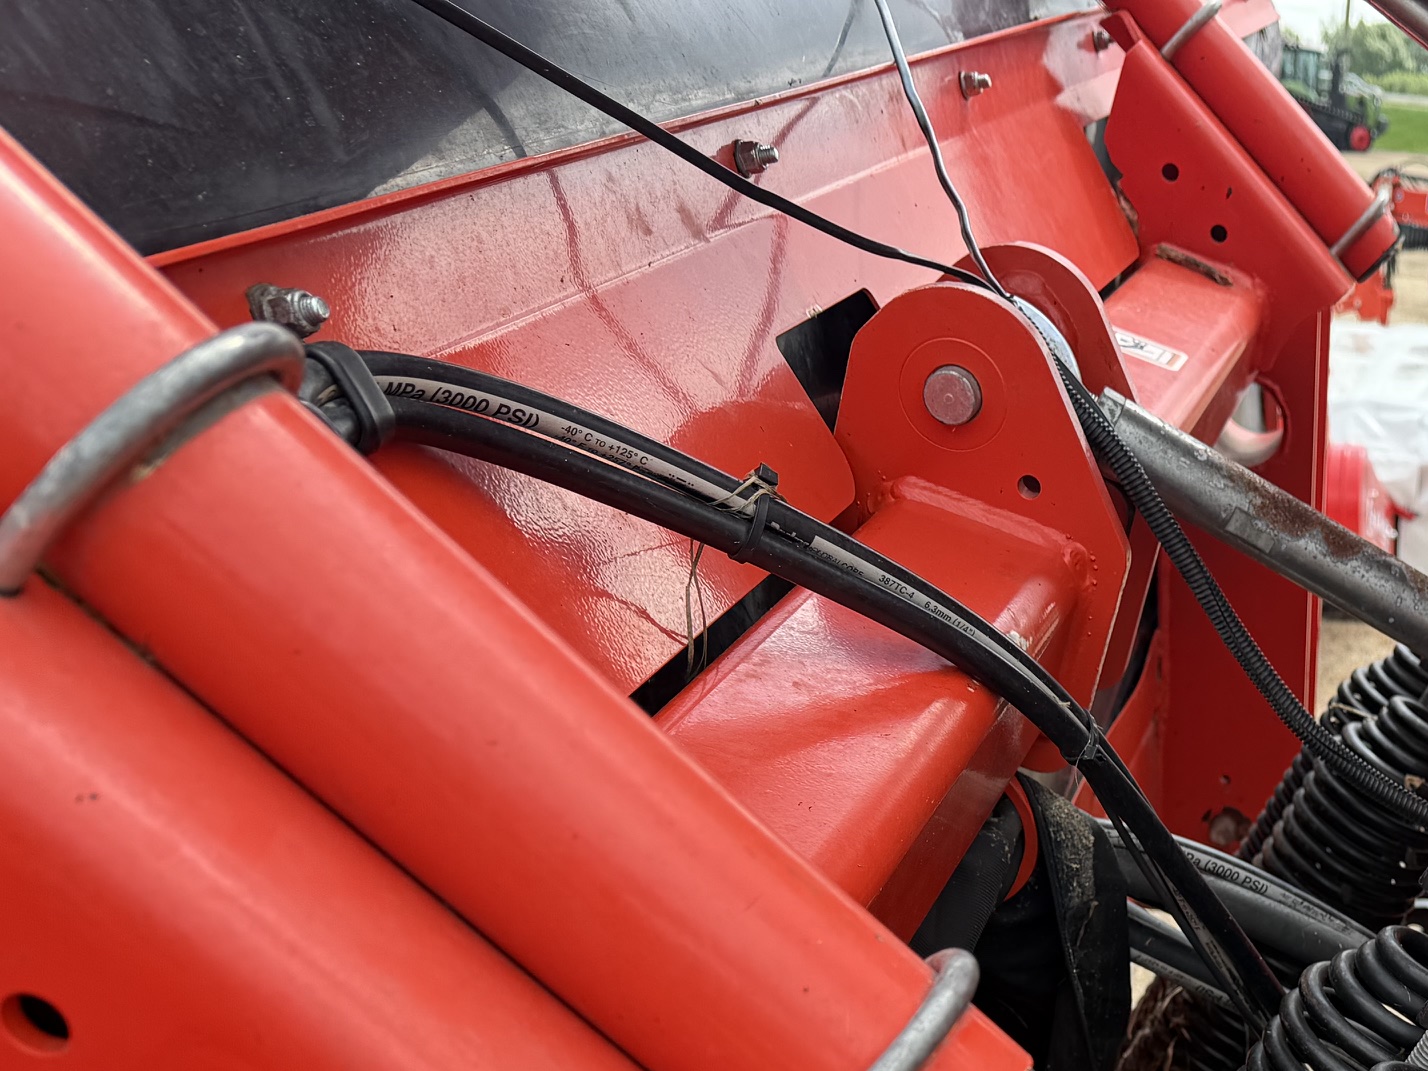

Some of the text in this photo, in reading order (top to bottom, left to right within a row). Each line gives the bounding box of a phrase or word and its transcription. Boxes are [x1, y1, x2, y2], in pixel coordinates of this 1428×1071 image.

[383, 381, 426, 399] MPa
[492, 403, 540, 429] PSI)
[584, 432, 593, 442] C
[639, 456, 649, 466] C
[878, 574, 915, 599] 387TC-4
[923, 601, 952, 622] 6.3mm
[1204, 858, 1240, 883] (3000
[1241, 873, 1269, 895] PSI)
